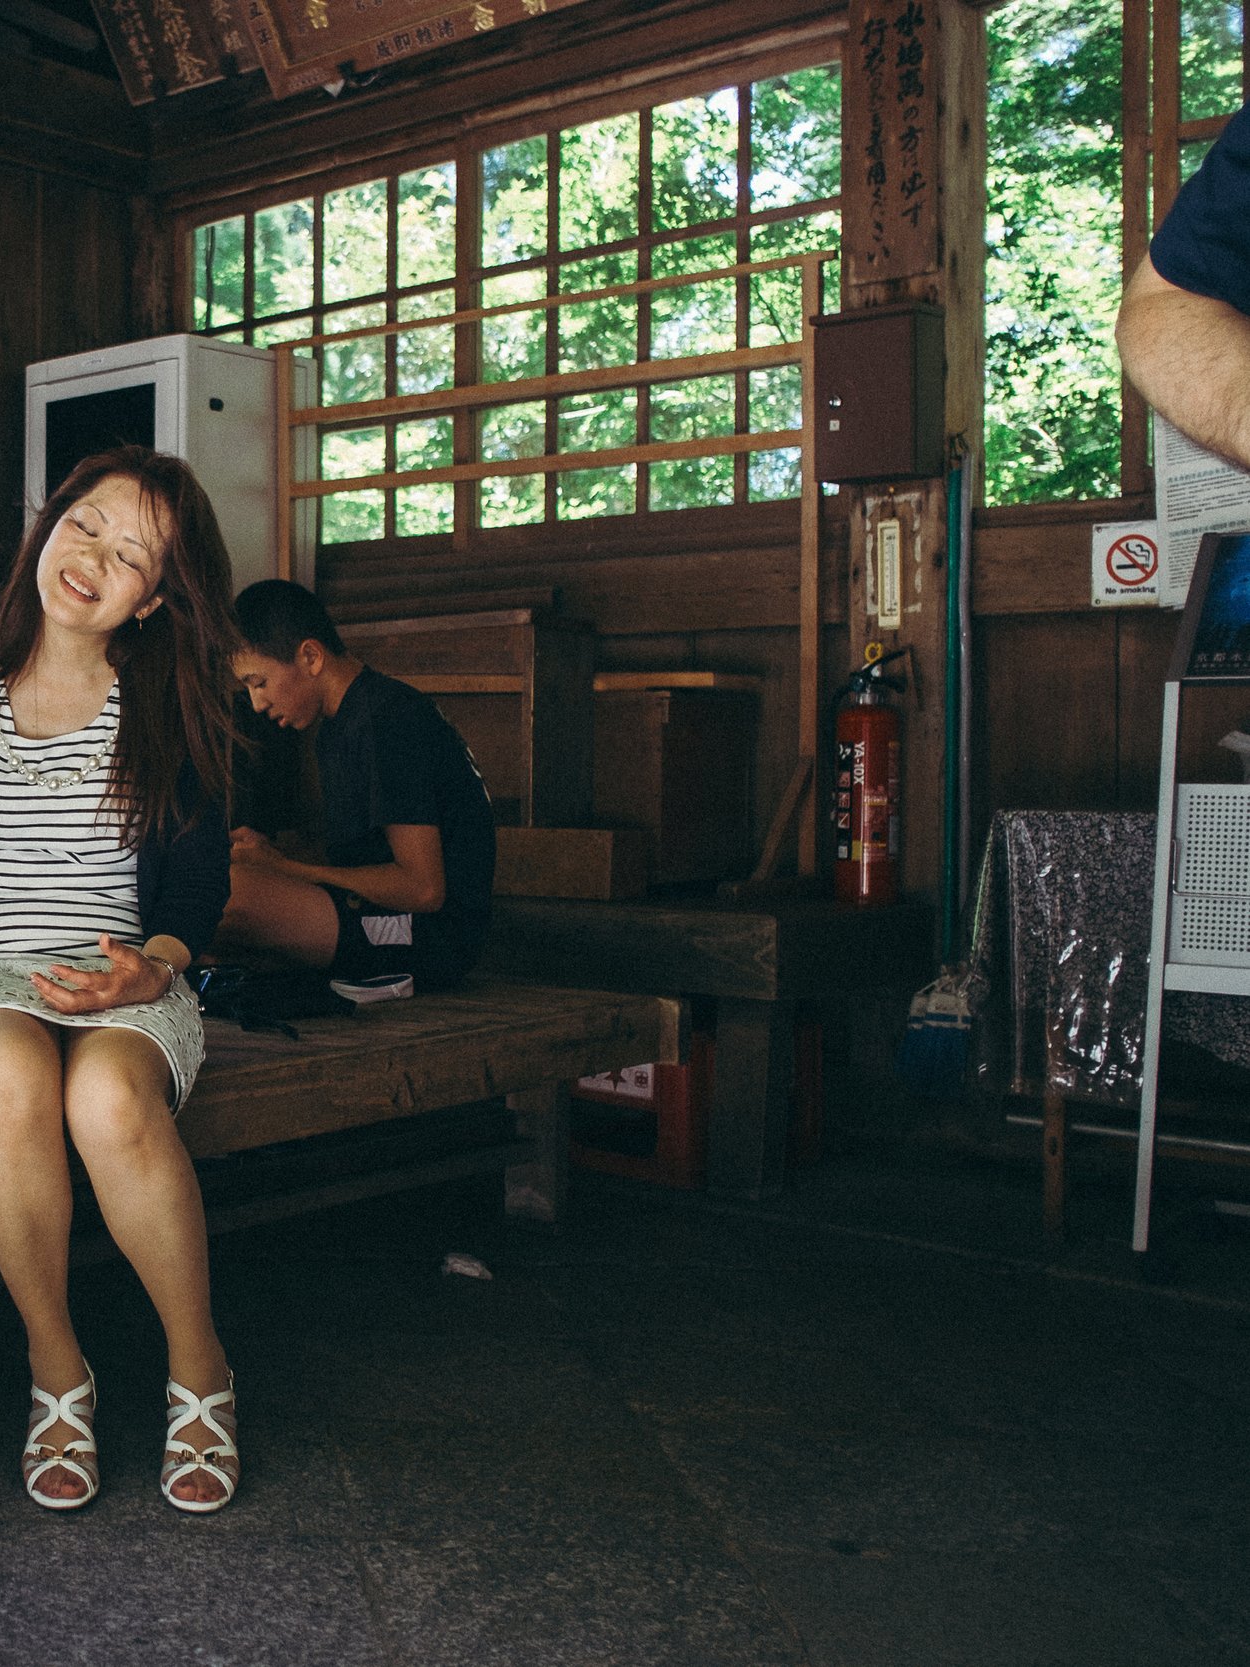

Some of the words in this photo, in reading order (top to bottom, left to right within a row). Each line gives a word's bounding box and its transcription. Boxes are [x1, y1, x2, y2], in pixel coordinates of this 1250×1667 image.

[1105, 587, 1117, 595] No
[1120, 586, 1156, 595] smoking
[853, 740, 865, 786] YA-10X
